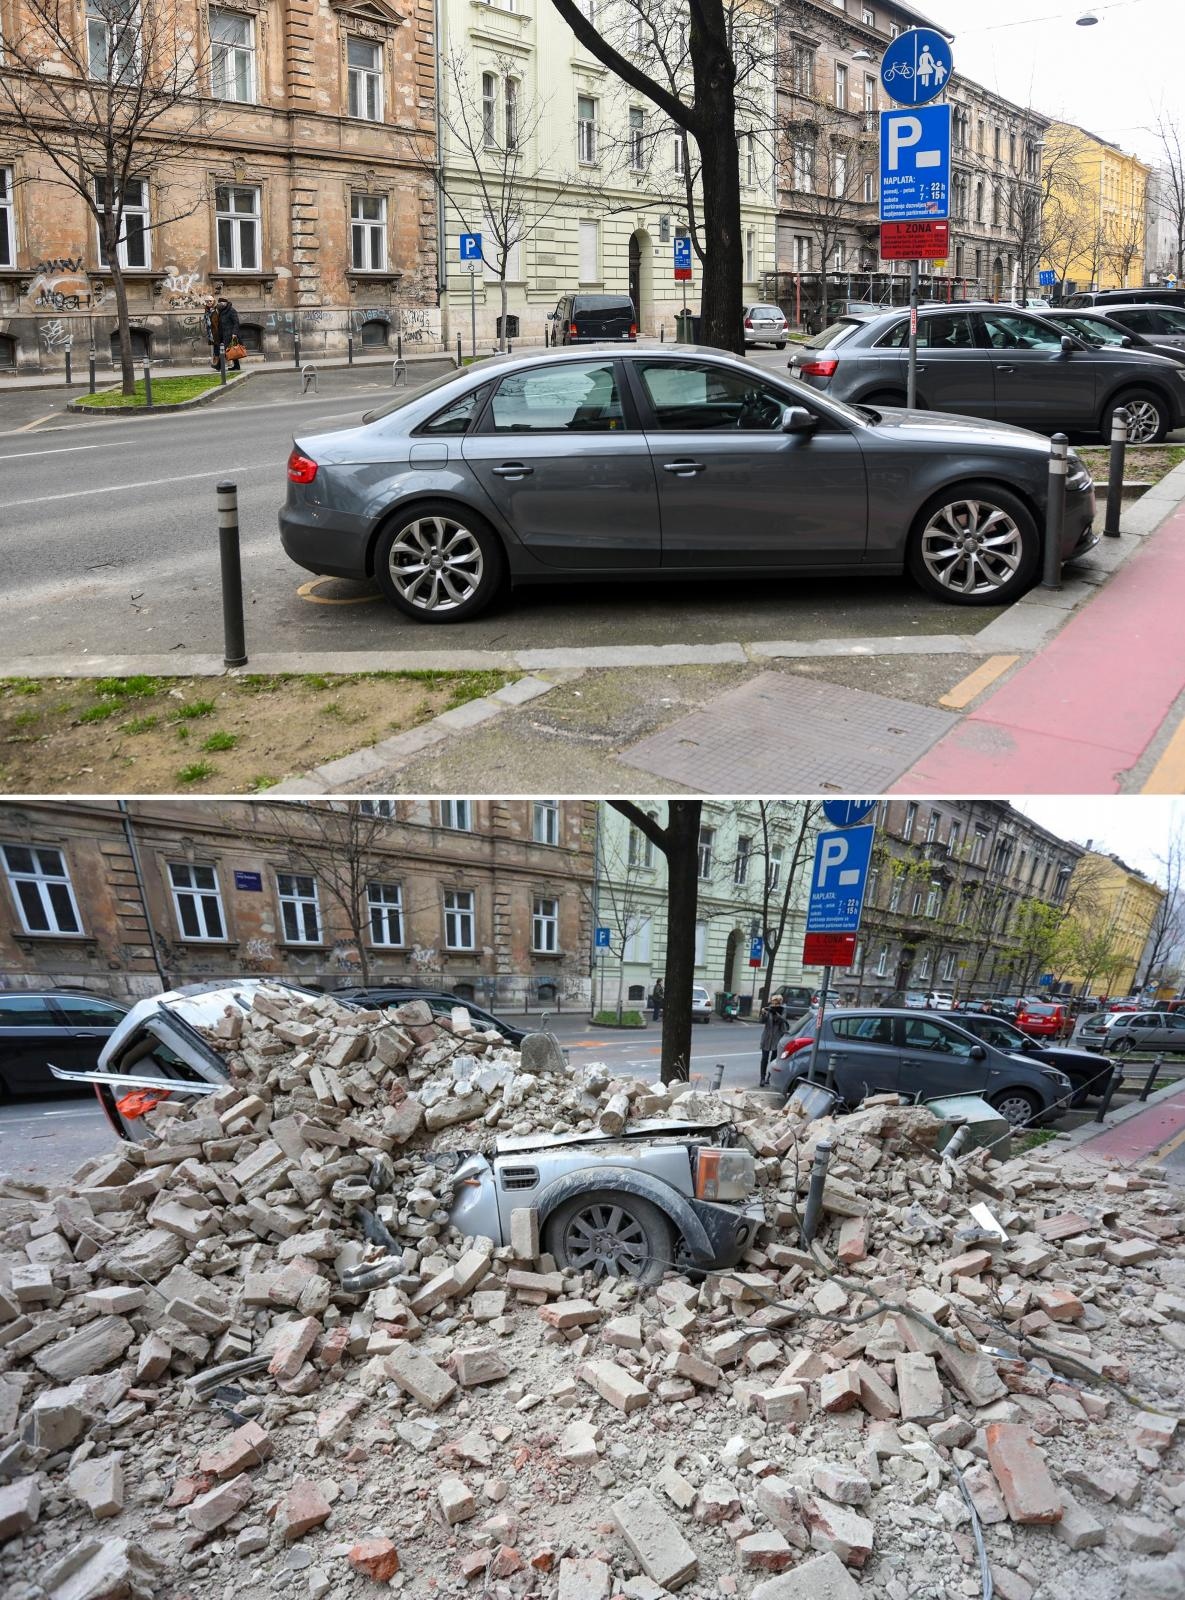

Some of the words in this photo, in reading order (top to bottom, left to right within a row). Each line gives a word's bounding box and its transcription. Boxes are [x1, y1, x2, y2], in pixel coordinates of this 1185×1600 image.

[888, 116, 922, 171] P
[884, 176, 915, 185] NAPLATA:
[920, 184, 924, 192] 7
[931, 191, 940, 199] 15
[941, 191, 945, 199] h
[906, 224, 931, 233] ZONA
[465, 238, 476, 255] P
[675, 239, 684, 255] P
[818, 837, 849, 887] P
[752, 938, 759, 949] P
